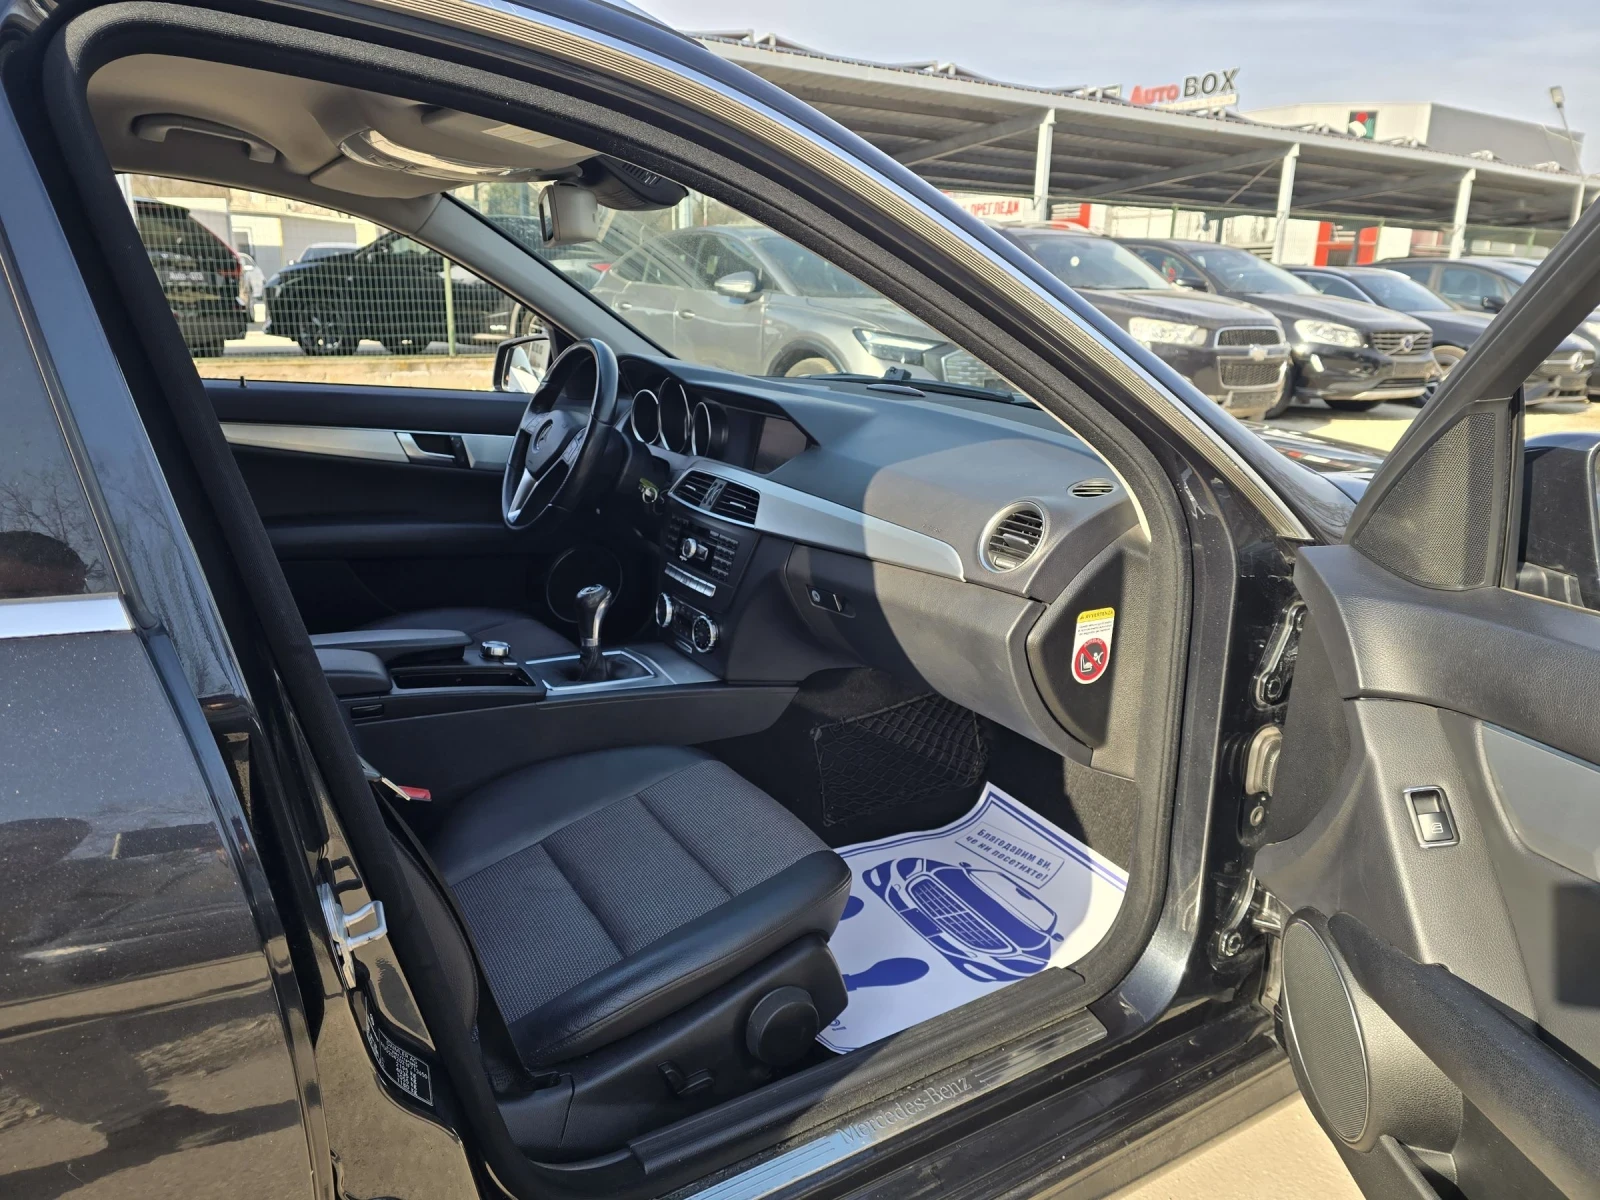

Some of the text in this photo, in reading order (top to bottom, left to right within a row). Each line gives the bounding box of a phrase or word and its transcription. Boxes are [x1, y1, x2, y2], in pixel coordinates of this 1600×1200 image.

[1183, 67, 1240, 97] BOX
[966, 835, 1049, 882] че ни посетихте!
[977, 828, 1037, 862] Благодарим
[836, 1076, 973, 1145] Mercedes-Benz
